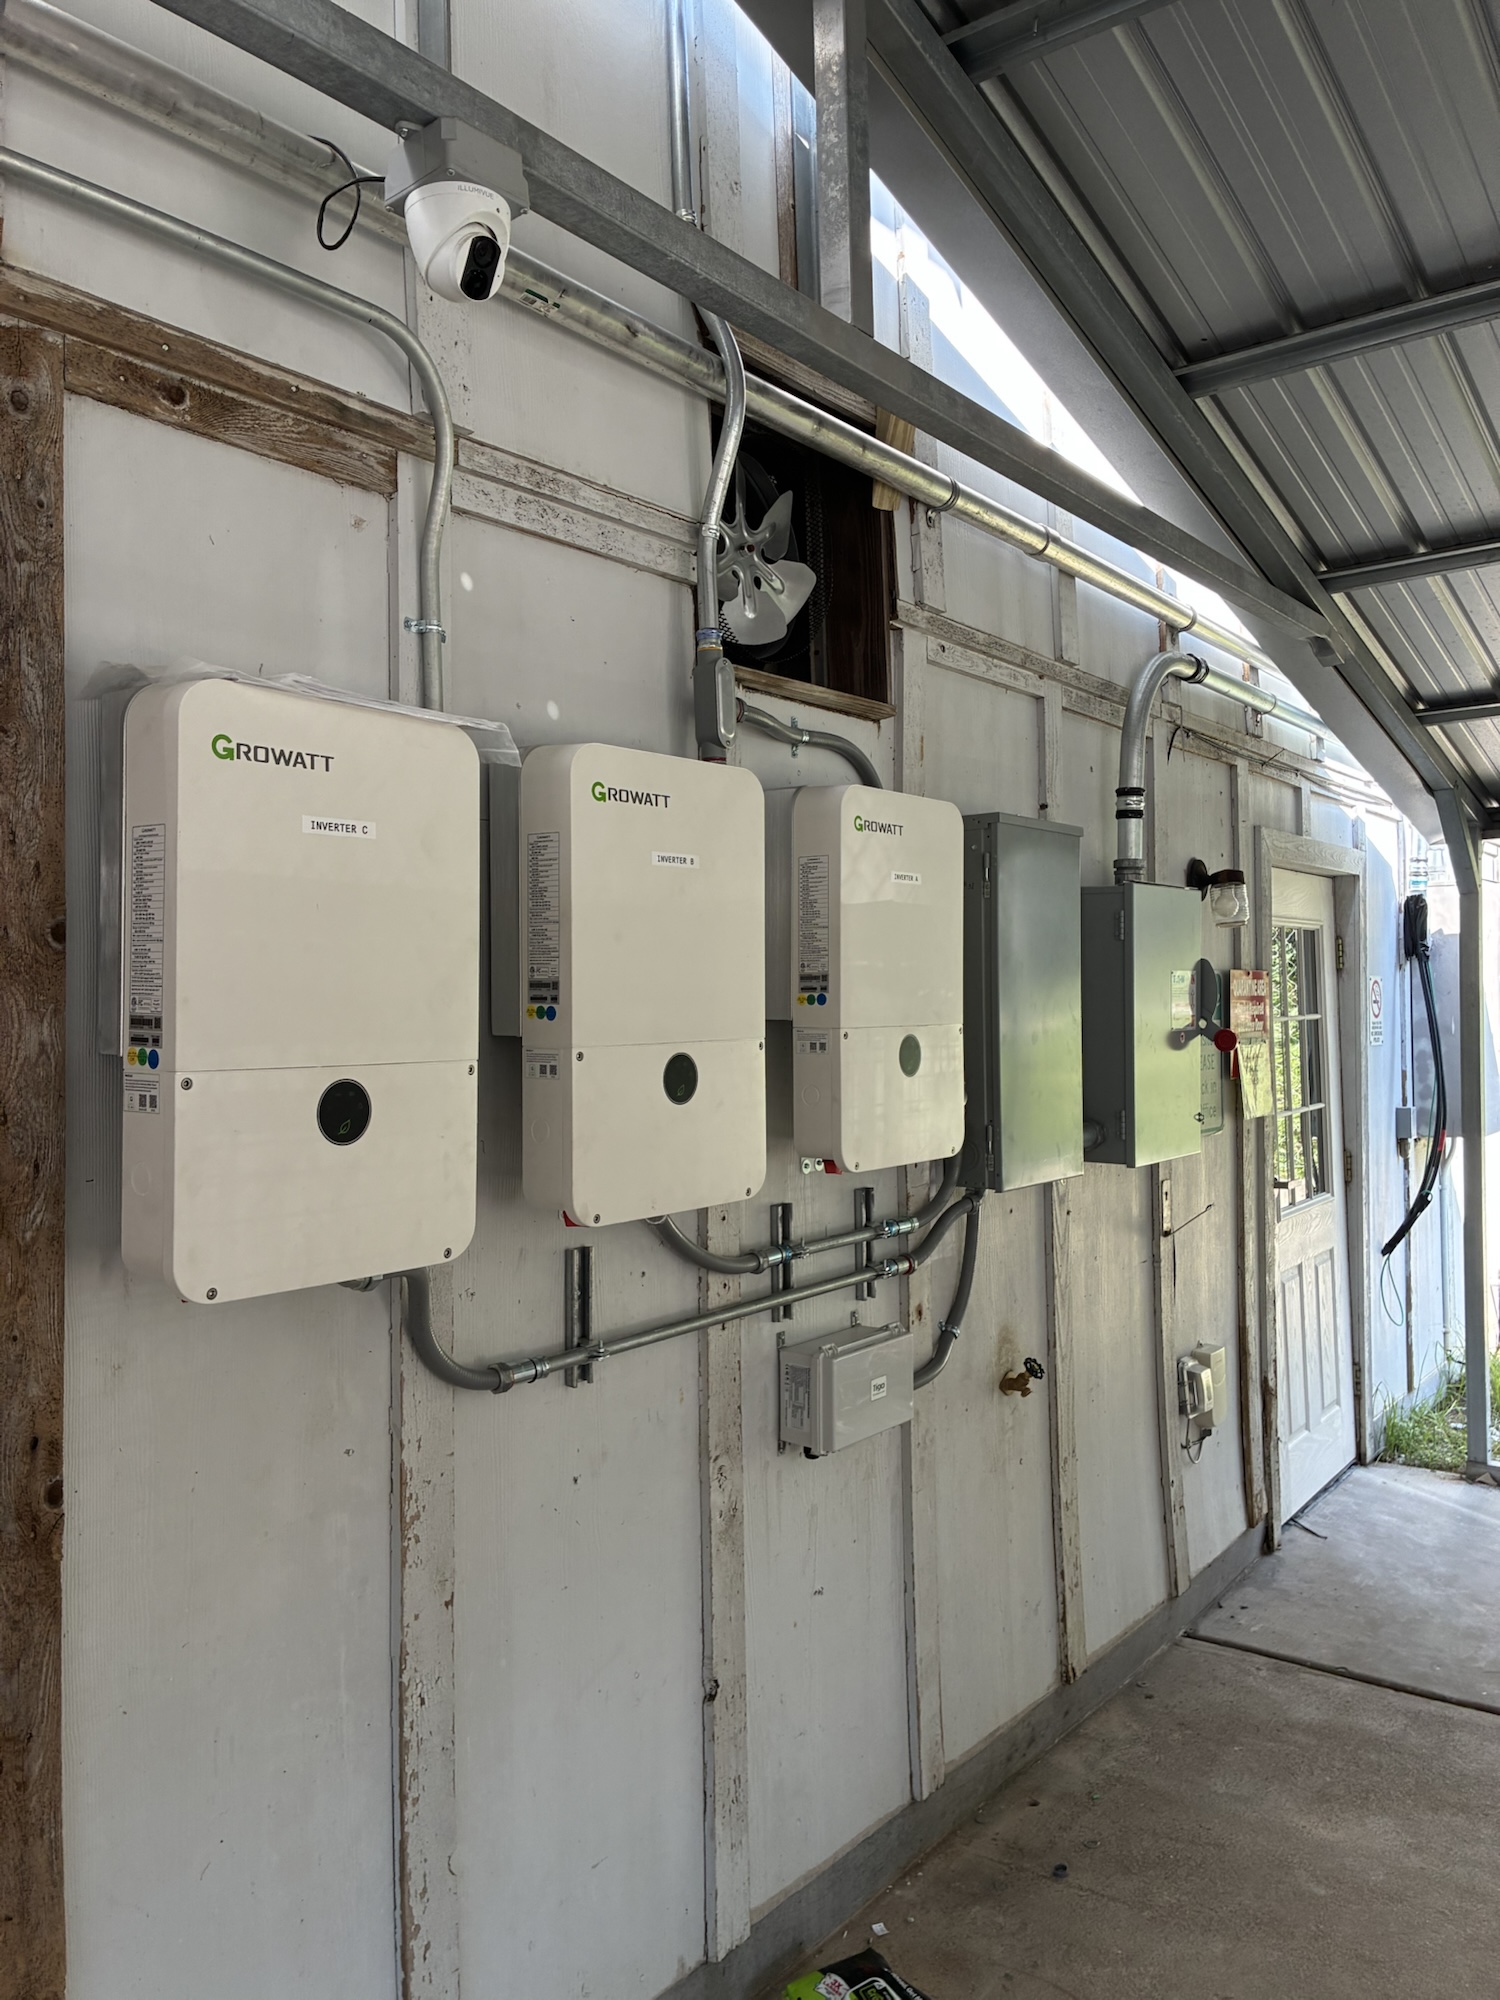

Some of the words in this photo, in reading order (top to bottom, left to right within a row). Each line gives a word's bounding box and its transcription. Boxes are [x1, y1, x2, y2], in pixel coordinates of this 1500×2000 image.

[211, 733, 335, 772] GROWATT
[591, 781, 671, 808] GROWATT
[310, 820, 357, 834] INVERTER
[362, 825, 369, 835] C
[854, 815, 904, 836] GROWATT
[657, 854, 687, 865] INVERTER
[873, 1382, 885, 1392] Tigo
